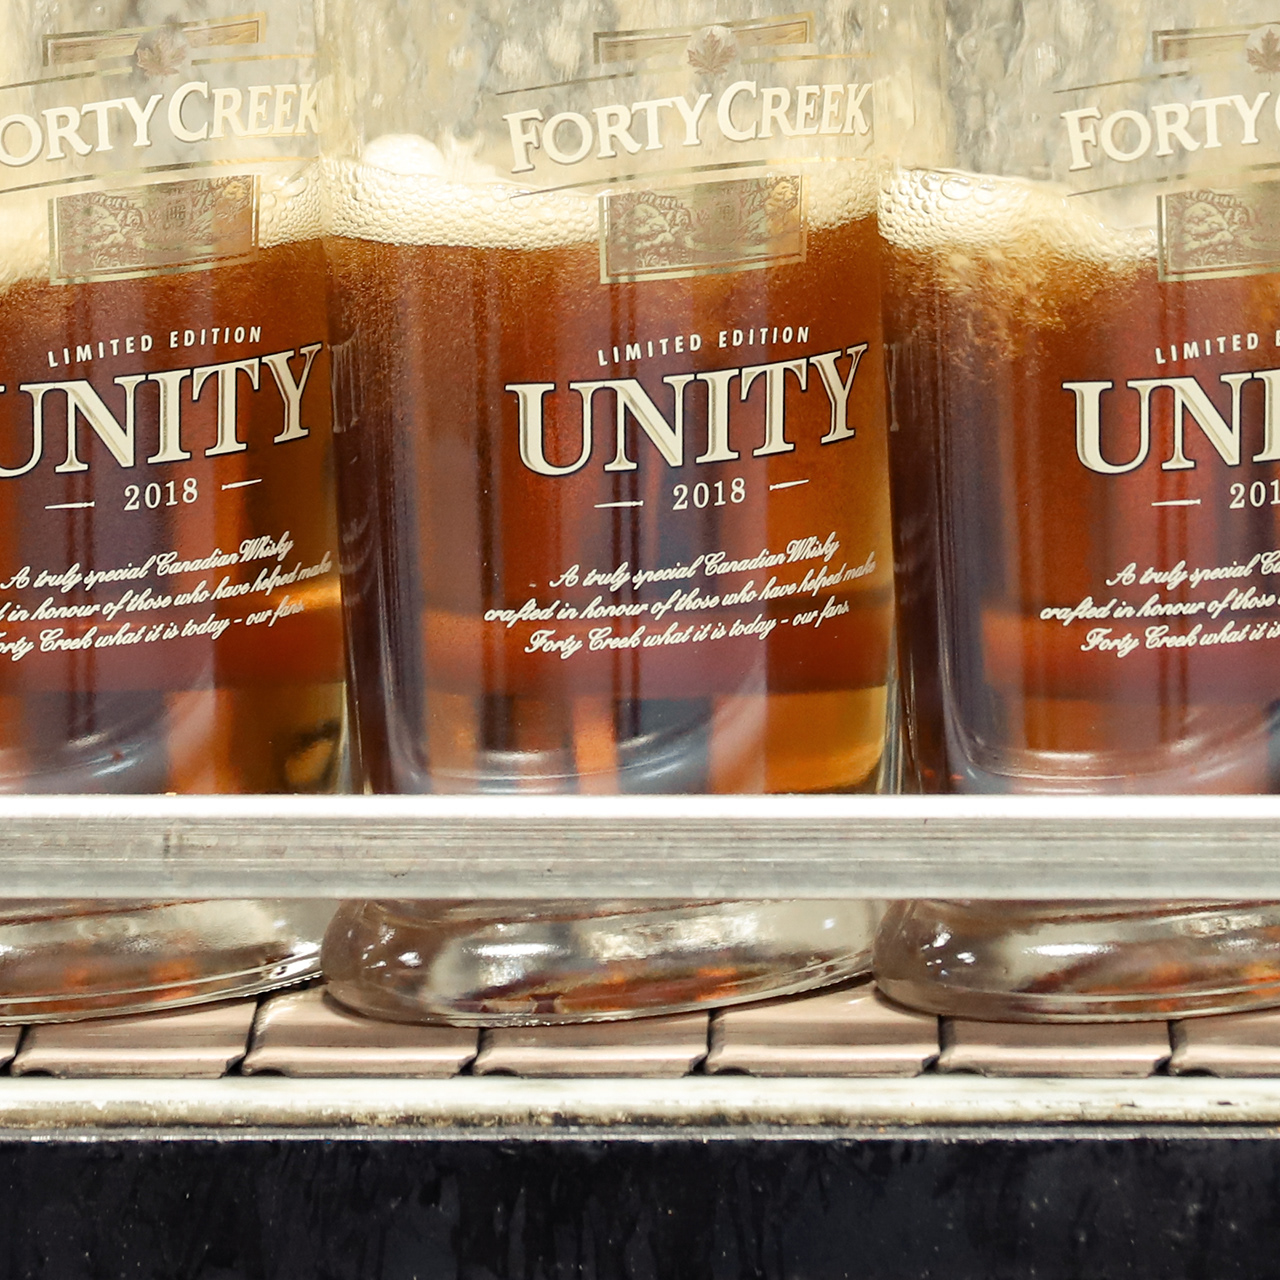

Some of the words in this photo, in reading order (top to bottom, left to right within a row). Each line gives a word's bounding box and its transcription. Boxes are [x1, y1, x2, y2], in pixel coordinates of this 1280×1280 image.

[502, 93, 711, 173] FORTY
[717, 80, 873, 142] CREEK
[1061, 91, 1270, 171] FORTY
[48, 334, 153, 368] LIMITED
[170, 326, 262, 348] EDITION
[598, 334, 702, 366] LIMITED
[718, 326, 810, 348] EDITION
[1155, 333, 1259, 364] LIMITED
[505, 343, 868, 476] UNITY
[123, 477, 198, 511] 2018
[672, 478, 746, 510] 2018
[0, 565, 31, 590] A
[32, 562, 84, 597] truly
[82, 554, 158, 592] special
[156, 547, 241, 577] Canadian
[238, 530, 294, 564] Whisky
[548, 563, 580, 588] A
[582, 562, 632, 593] truly
[631, 554, 706, 591] special
[704, 548, 787, 577] Canadian
[785, 530, 841, 564] Whisky
[1105, 562, 1137, 587] A
[1138, 559, 1189, 591] truly
[1188, 552, 1261, 589] special
[6, 604, 31, 623] in
[29, 596, 102, 621] honour
[101, 588, 134, 622] of
[125, 587, 173, 613] those
[172, 579, 211, 607] who
[209, 575, 251, 601] have
[249, 561, 302, 597] helped
[483, 597, 562, 629] crafted
[555, 602, 580, 621] in
[579, 595, 649, 620] honour
[649, 588, 682, 621] of
[673, 587, 721, 612] those
[721, 579, 759, 607] who
[757, 575, 798, 601] have
[795, 562, 848, 598] helped
[1039, 595, 1118, 627] crafted
[1112, 600, 1136, 619] in
[1135, 593, 1206, 618] honour
[1206, 587, 1239, 620] of
[1230, 585, 1277, 611] those
[39, 625, 99, 653] Creek
[93, 621, 148, 649] what
[143, 622, 166, 643] it
[161, 621, 180, 641] is
[180, 612, 231, 641] today
[245, 608, 274, 626] our
[523, 629, 584, 660] Forty
[588, 625, 647, 652] Creek
[642, 621, 695, 648] what
[691, 622, 713, 643] it
[709, 621, 728, 641] is
[728, 613, 777, 641] today
[791, 609, 819, 627] our
[1080, 627, 1140, 659] Forty
[1144, 623, 1203, 650] Creek
[1198, 620, 1252, 646] what
[1248, 621, 1269, 642] it
